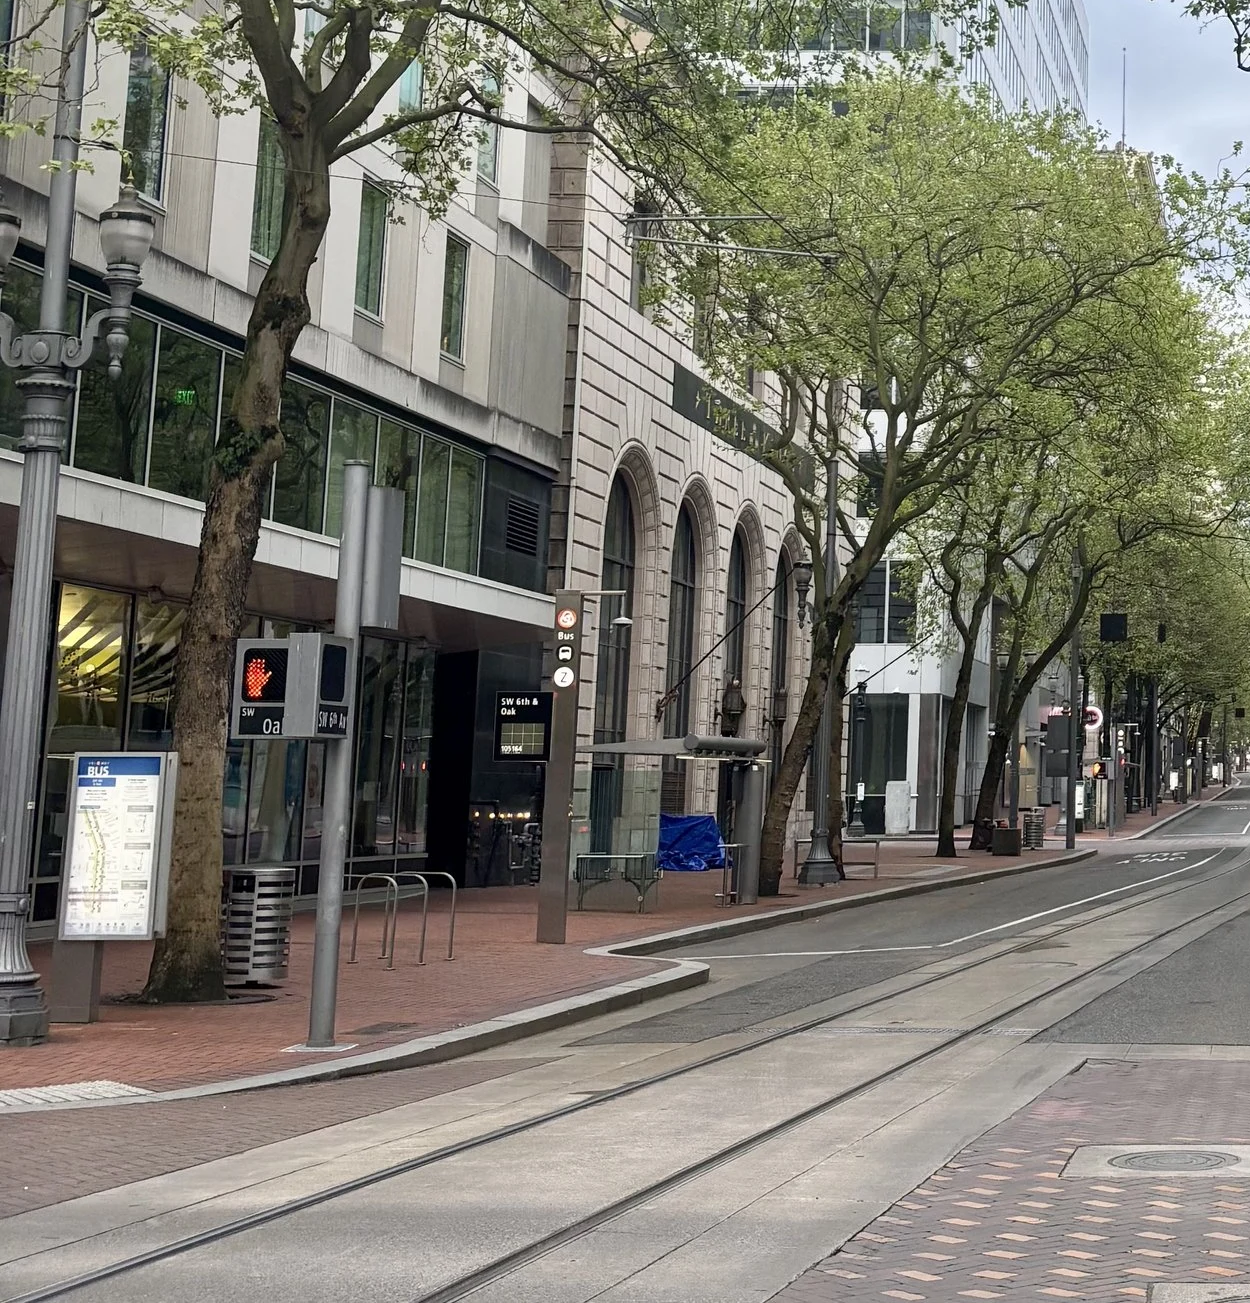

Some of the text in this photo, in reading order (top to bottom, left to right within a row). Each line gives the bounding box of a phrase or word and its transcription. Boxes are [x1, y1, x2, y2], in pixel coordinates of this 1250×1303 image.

[557, 631, 575, 641] Bus
[501, 697, 539, 706] SW 6th &
[241, 707, 255, 717] SW
[500, 707, 516, 716] Oak
[318, 711, 328, 728] SW
[262, 718, 283, 735] Oa
[87, 766, 109, 776] BUS
